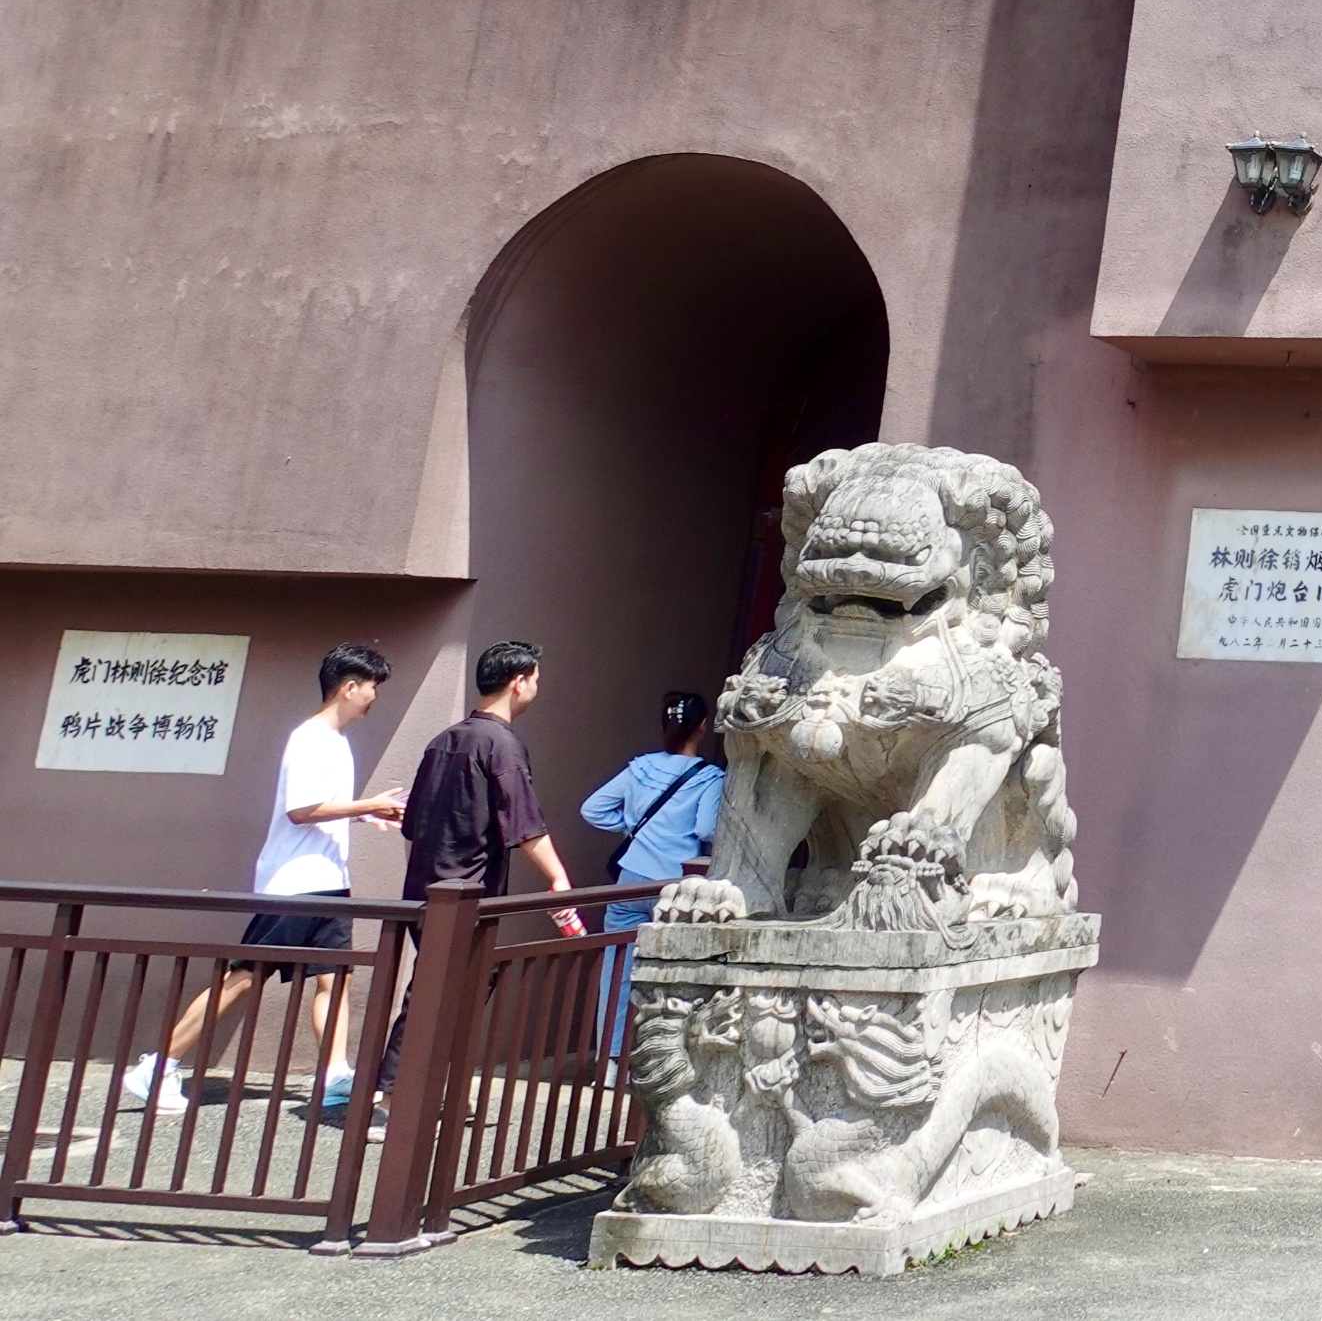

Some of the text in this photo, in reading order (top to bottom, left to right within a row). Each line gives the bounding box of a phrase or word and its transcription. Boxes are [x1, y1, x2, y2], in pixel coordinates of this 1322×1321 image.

[69, 656, 229, 687] 虎门林则徐纪念馆
[58, 711, 219, 744] 鸦片战争博物馆
